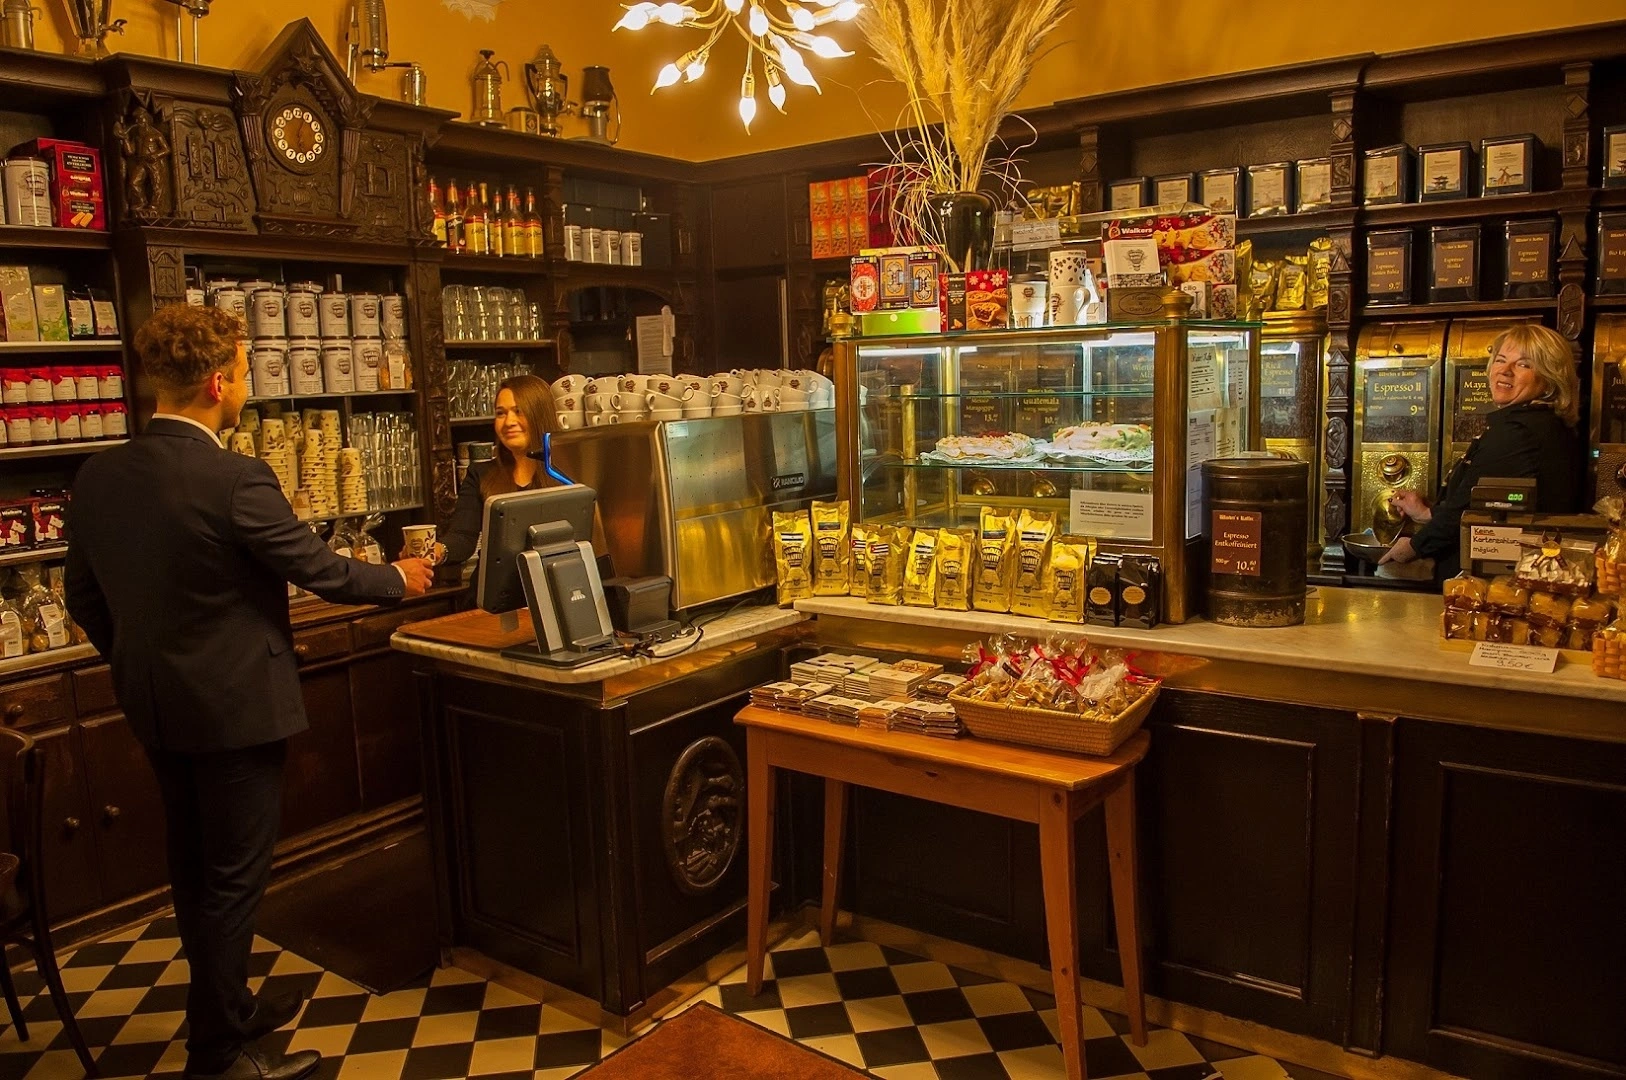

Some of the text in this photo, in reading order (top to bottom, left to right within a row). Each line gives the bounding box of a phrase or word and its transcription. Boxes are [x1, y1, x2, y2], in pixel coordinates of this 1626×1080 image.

[1121, 227, 1153, 235] Walkers
[1374, 382, 1414, 396] Espresso
[1463, 381, 1487, 391] Maya
[1474, 527, 1494, 535] Keine
[1223, 532, 1249, 540] Espresso
[1214, 540, 1257, 549] Entkoffeiniert
[1473, 546, 1499, 554] möglich
